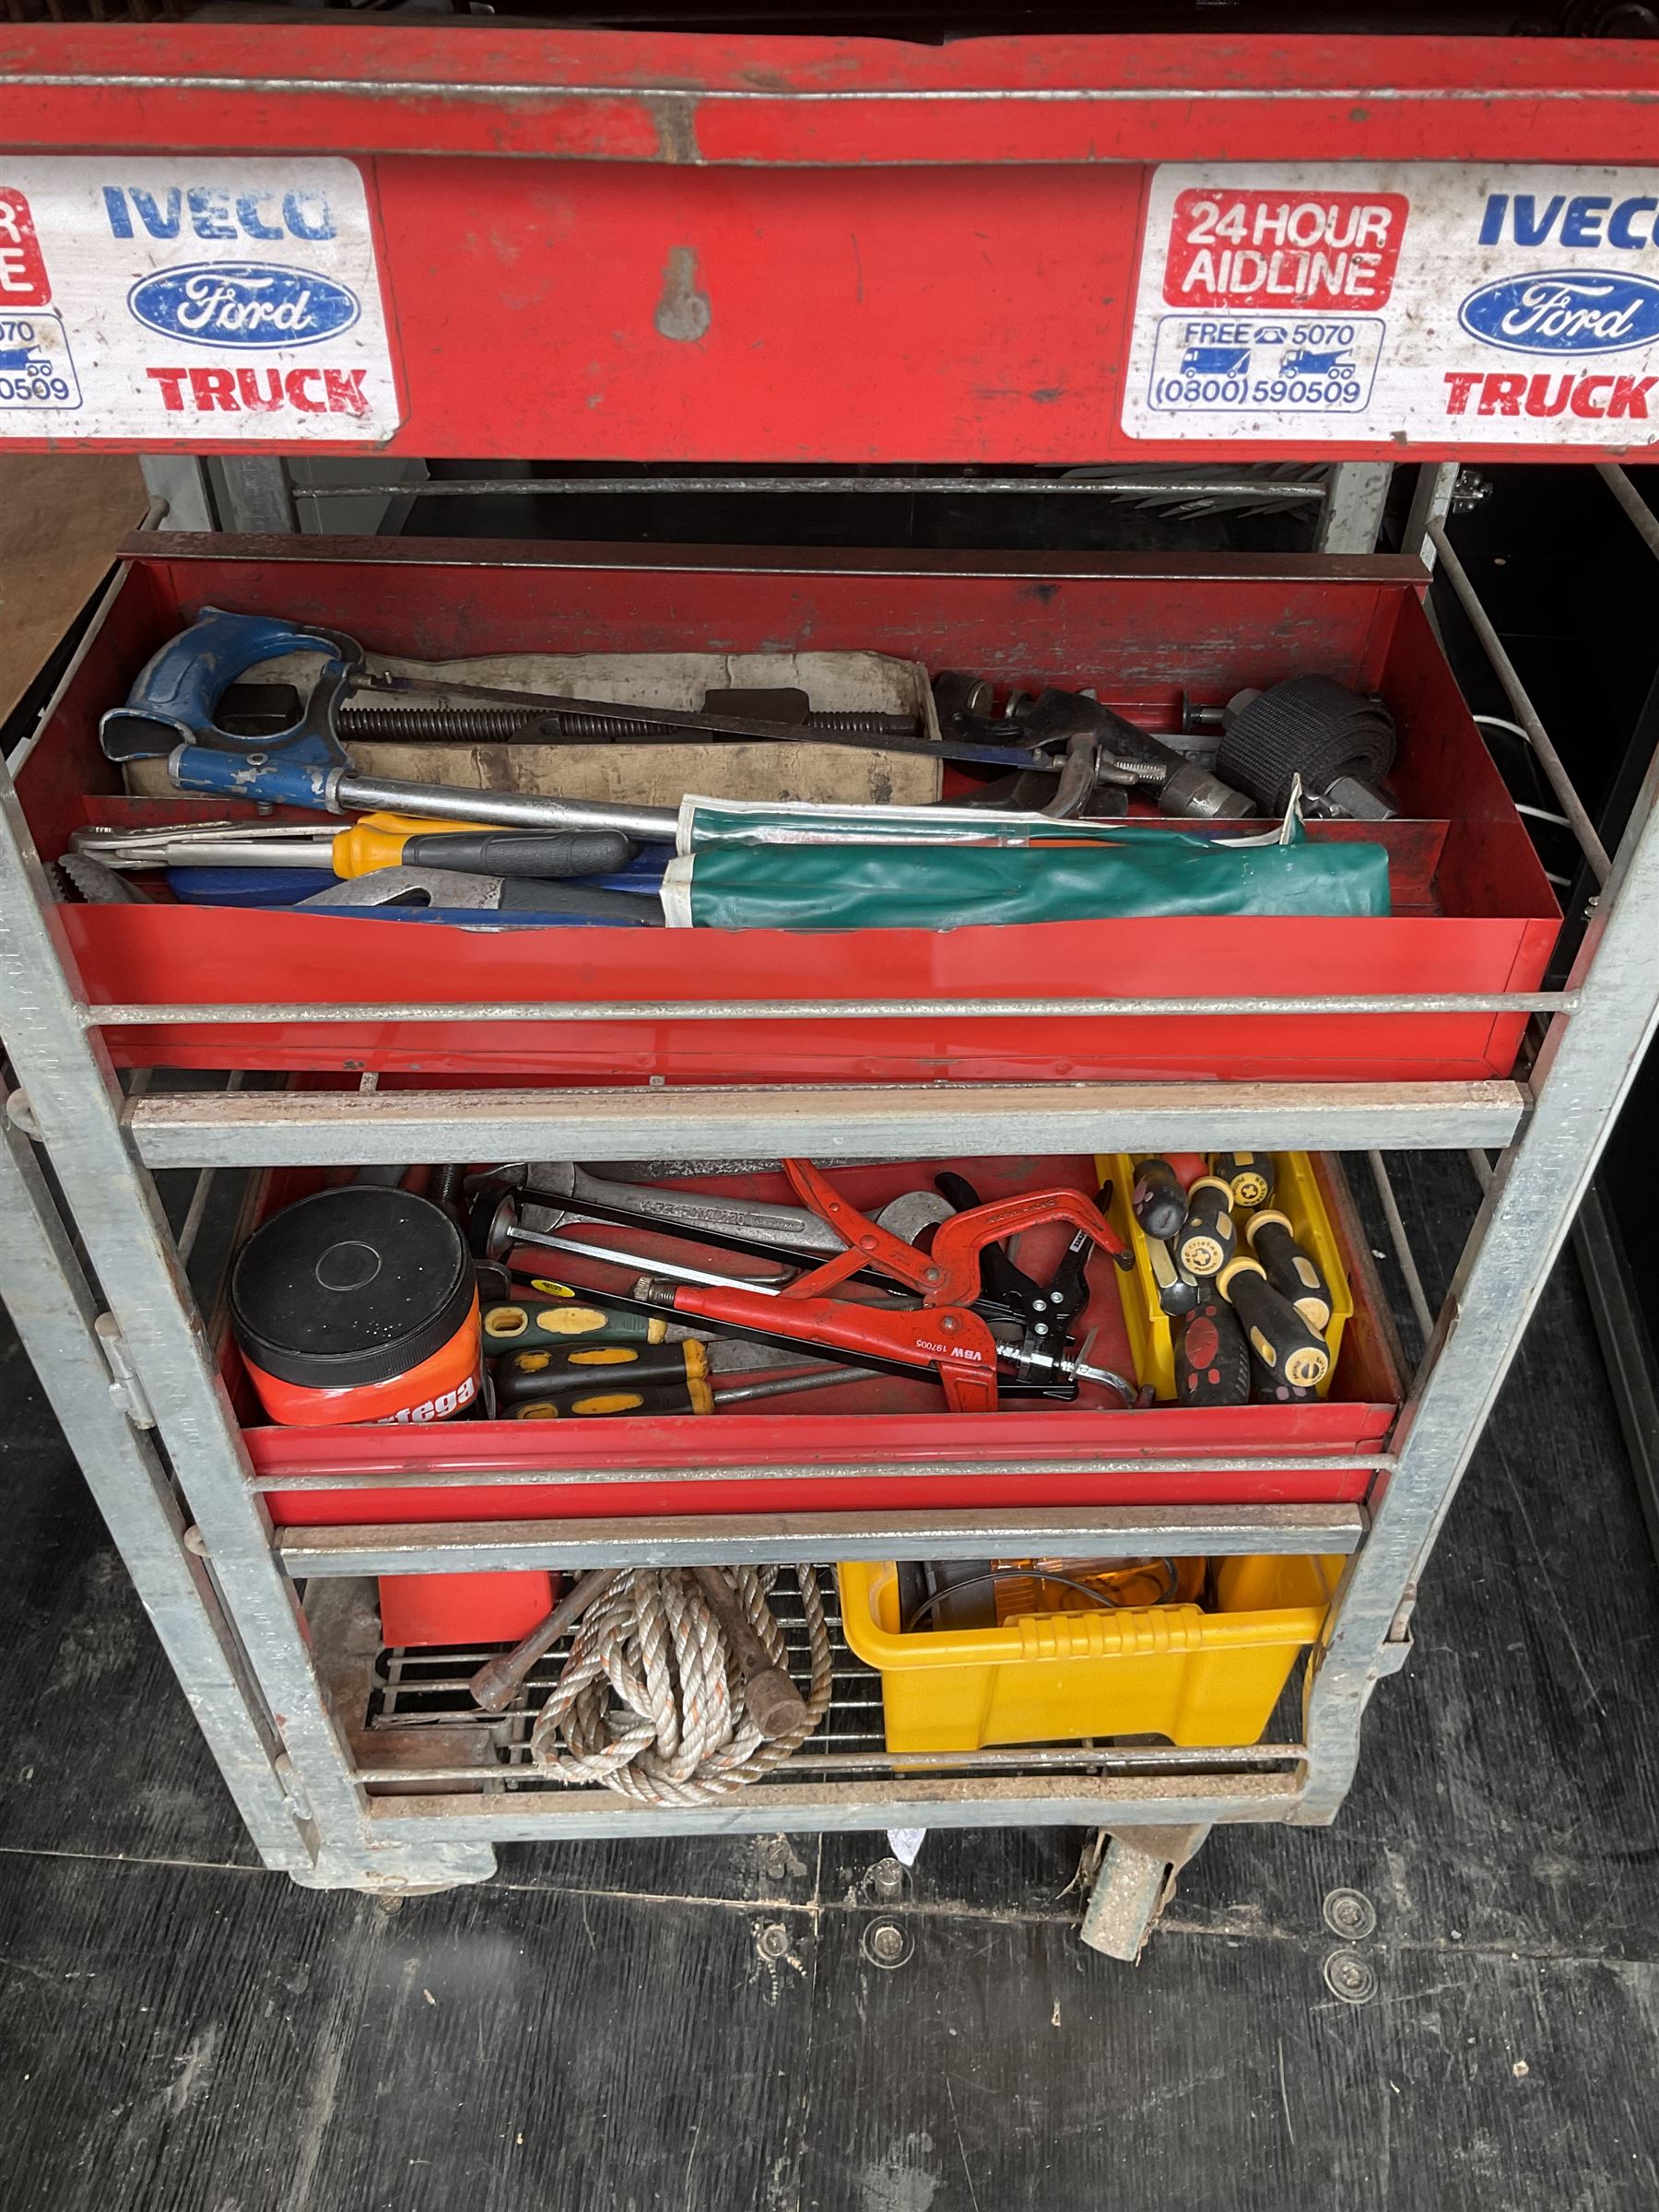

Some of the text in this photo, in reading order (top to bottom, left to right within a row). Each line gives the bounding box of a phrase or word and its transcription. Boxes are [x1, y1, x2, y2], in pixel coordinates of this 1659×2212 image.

[102, 185, 338, 241] IVECO
[1187, 201, 1393, 248] 24 HOUR
[1477, 194, 1659, 251] IVEC
[1182, 248, 1382, 297] AIDLINE
[176, 275, 312, 331] Ford
[1501, 281, 1644, 338] Ford
[0, 321, 34, 342] 70
[1184, 323, 1355, 346] FREE 5070
[146, 367, 372, 413] TRUCK
[1443, 371, 1659, 418] TRUCK
[915, 1338, 982, 1362] VBW 197005
